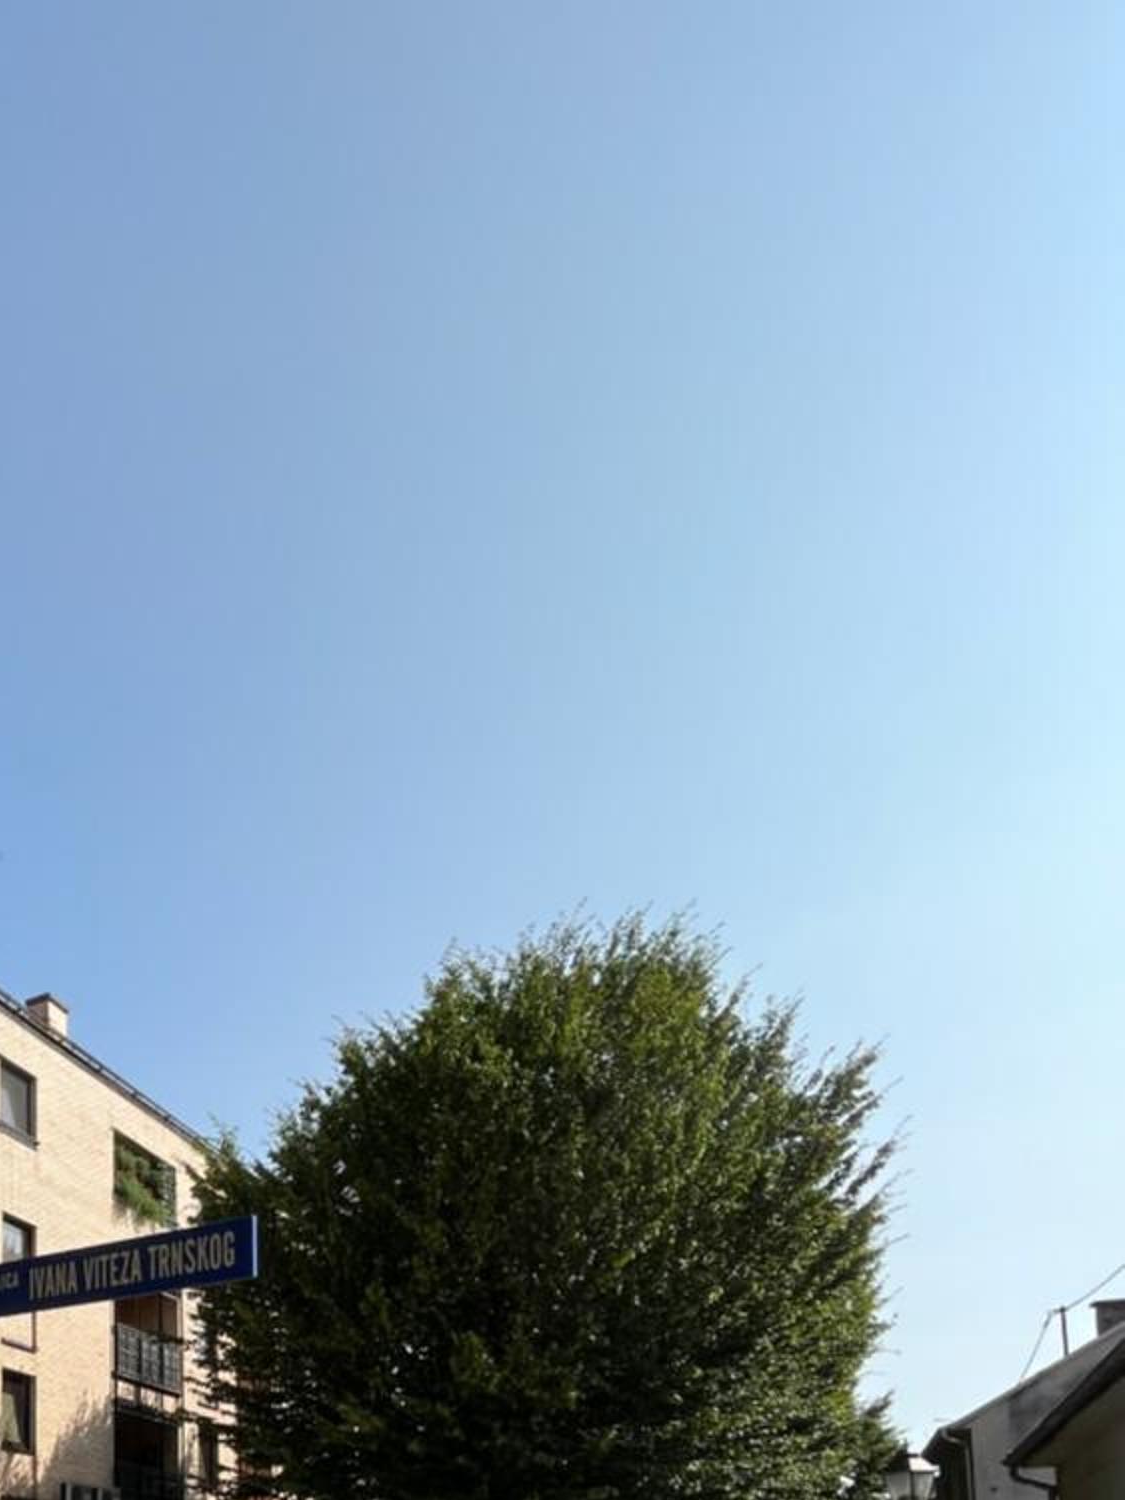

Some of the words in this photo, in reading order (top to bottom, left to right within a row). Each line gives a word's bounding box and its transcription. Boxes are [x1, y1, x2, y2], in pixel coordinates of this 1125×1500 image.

[29, 1261, 77, 1301] IVANA
[82, 1250, 142, 1291] VITEZA
[148, 1231, 236, 1281] TRNSKOG
